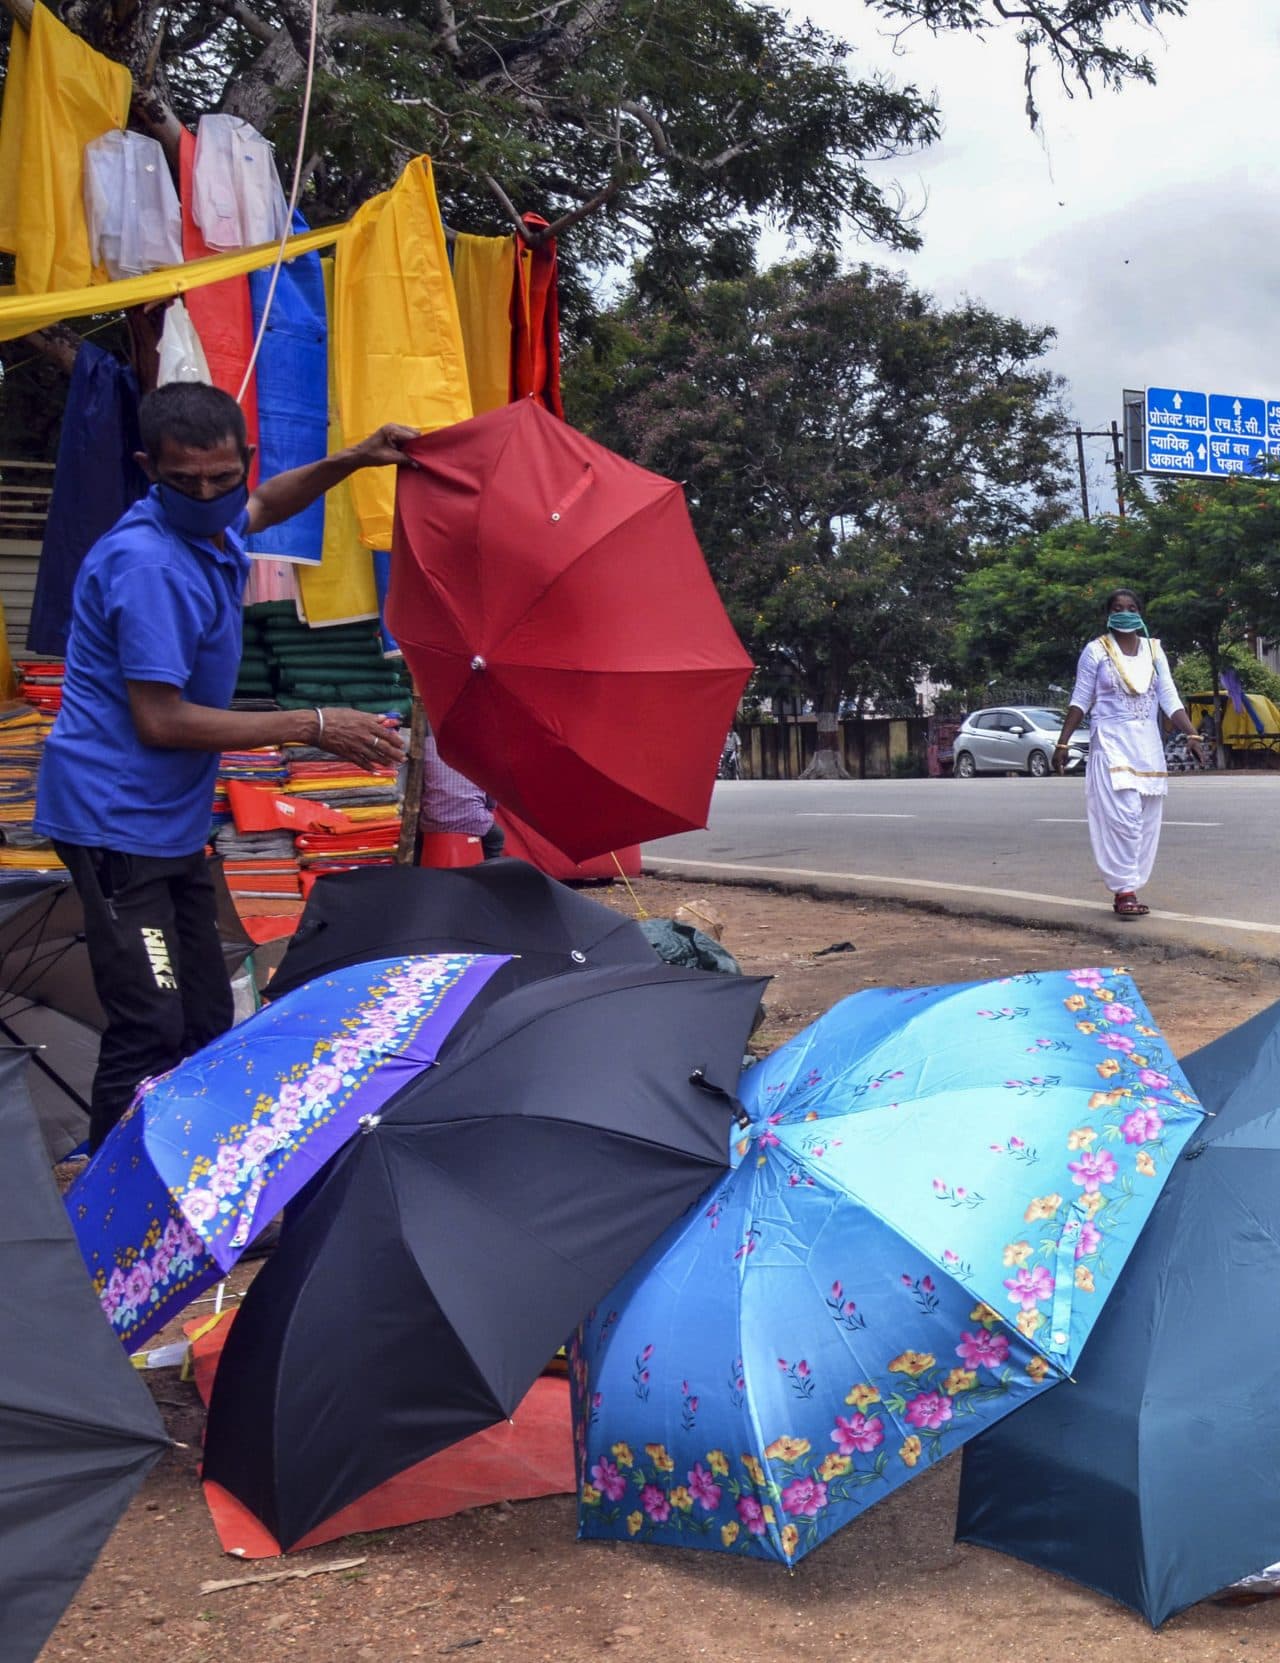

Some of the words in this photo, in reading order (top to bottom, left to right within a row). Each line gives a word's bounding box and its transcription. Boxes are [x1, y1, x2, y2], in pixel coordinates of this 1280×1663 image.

[1149, 407, 1183, 426] प्रोजेक्ट
[1185, 415, 1206, 428] भवन
[1150, 433, 1189, 451] न्यायिक
[1151, 451, 1194, 468] अकादमी
[141, 927, 178, 990] NIKE
